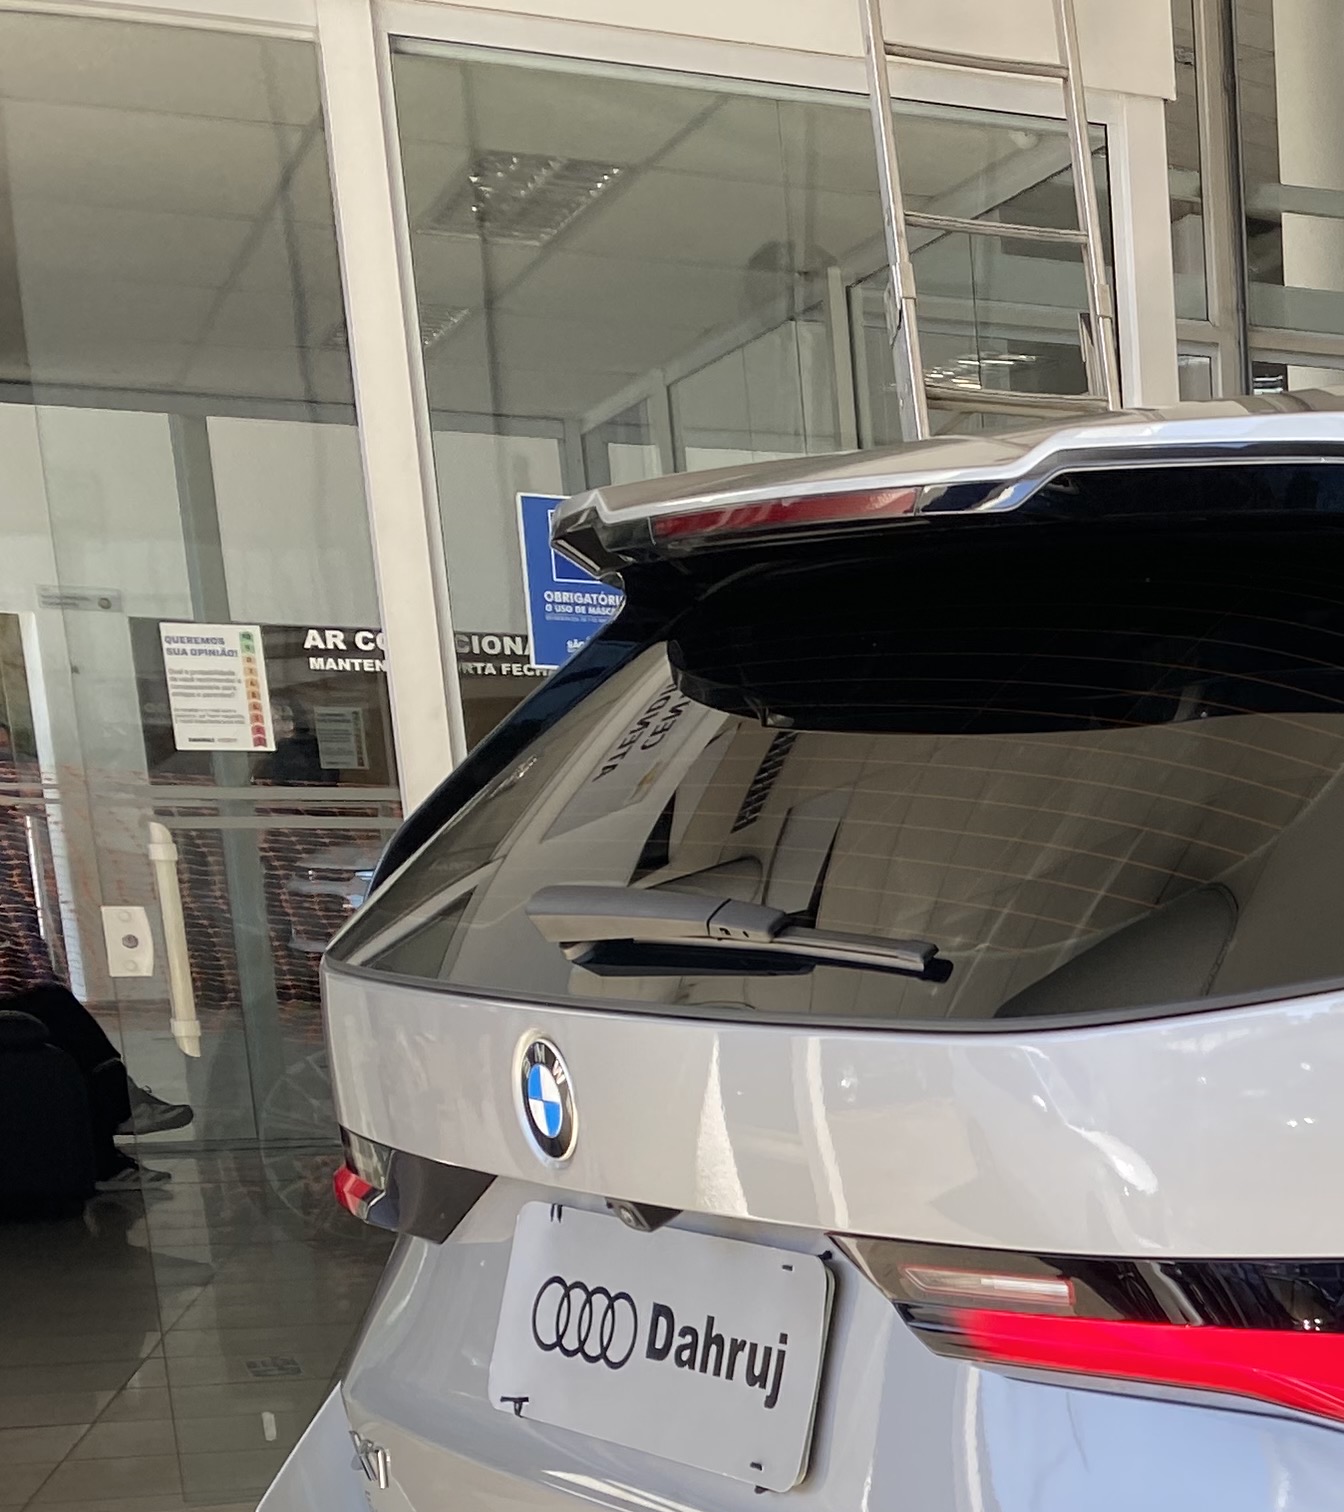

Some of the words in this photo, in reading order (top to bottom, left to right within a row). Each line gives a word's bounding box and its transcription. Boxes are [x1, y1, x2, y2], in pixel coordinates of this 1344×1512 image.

[554, 604, 573, 613] USO
[164, 635, 225, 646] QUEREMOS
[303, 629, 348, 651] AR
[166, 647, 189, 656] SUA
[645, 1301, 789, 1409] Dahruj
